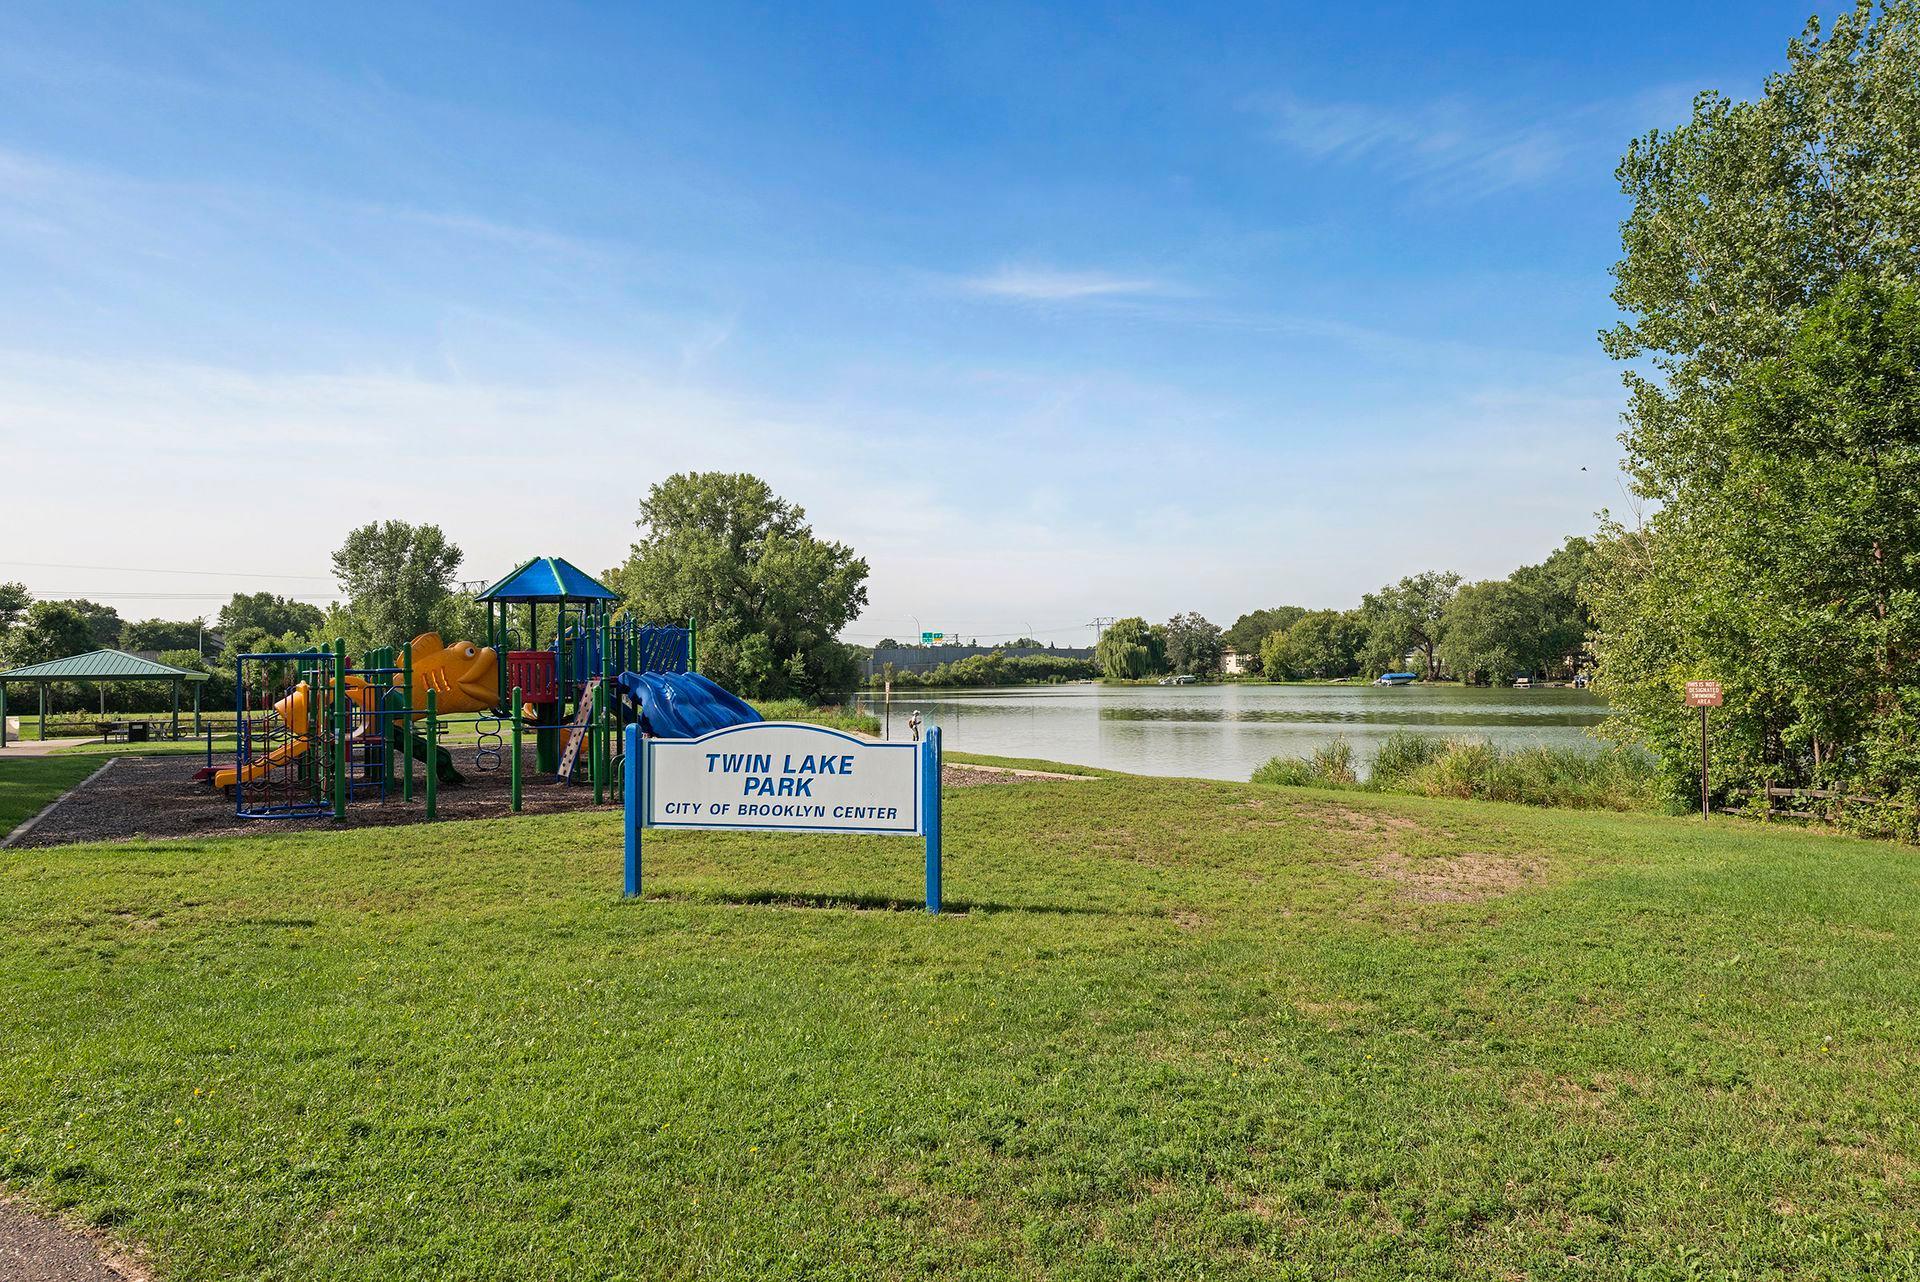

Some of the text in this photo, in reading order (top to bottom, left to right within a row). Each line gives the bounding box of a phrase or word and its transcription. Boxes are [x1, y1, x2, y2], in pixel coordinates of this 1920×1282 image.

[705, 753, 855, 775] TWIN LAKE
[743, 776, 815, 797] PARK
[665, 802, 898, 820] CITY OF BROOKLYN CENTER
